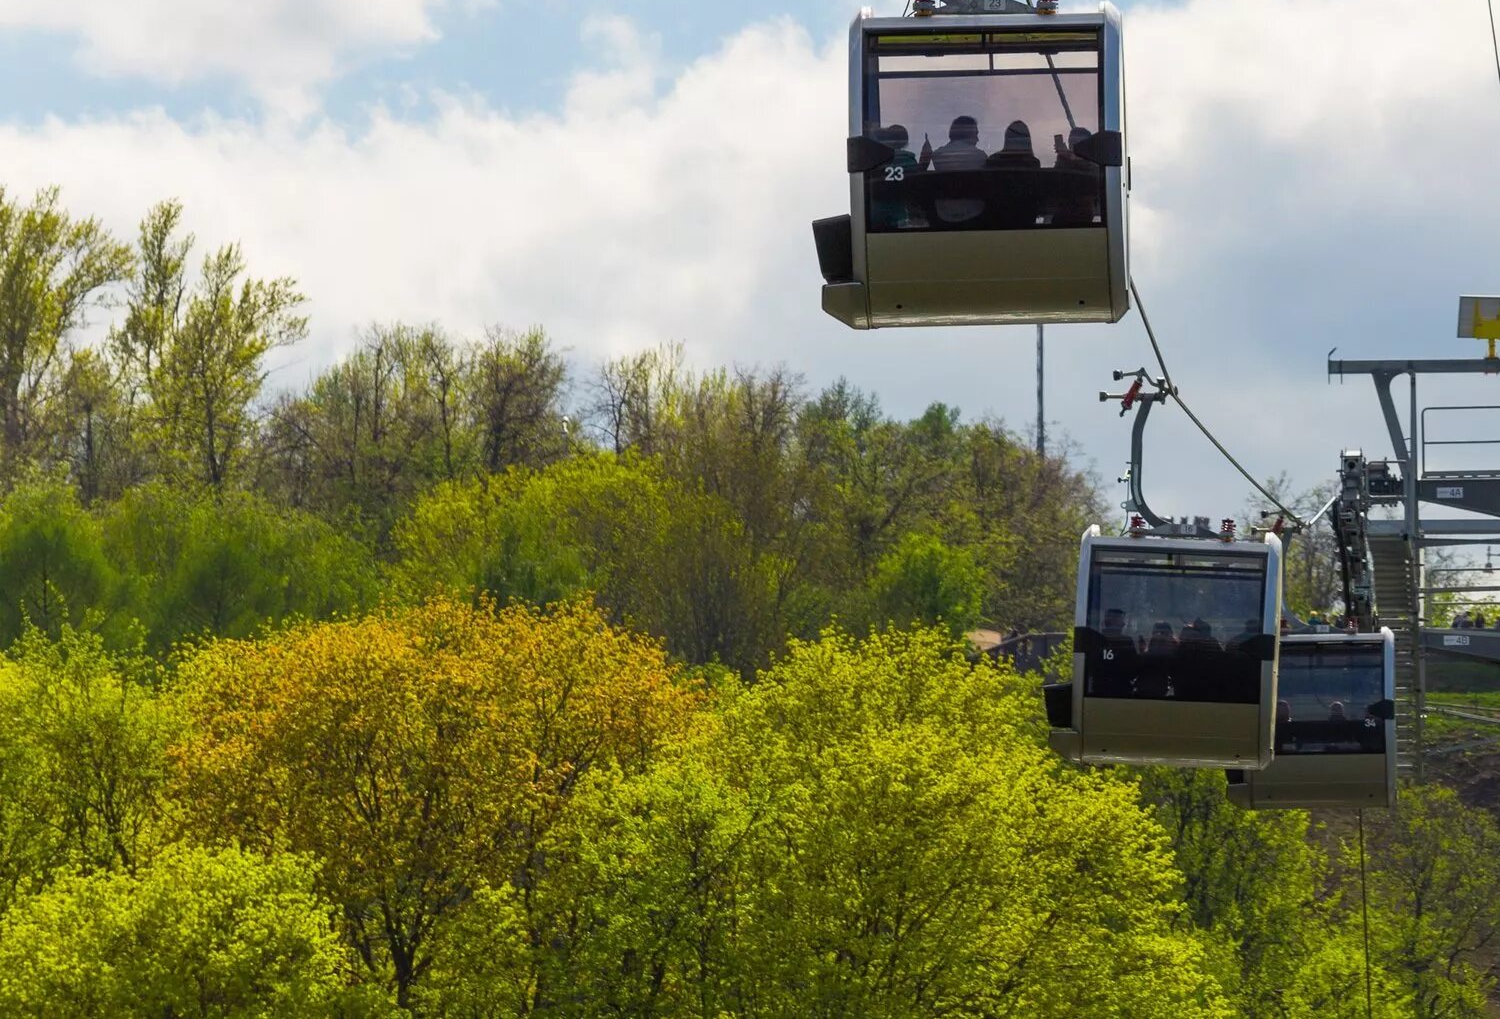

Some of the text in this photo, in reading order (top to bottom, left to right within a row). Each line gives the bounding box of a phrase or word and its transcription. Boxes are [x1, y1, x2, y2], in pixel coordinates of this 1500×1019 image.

[885, 166, 904, 181] 23
[1449, 488, 1461, 497] 4A
[1103, 649, 1114, 660] 16
[1364, 718, 1376, 728] 34
